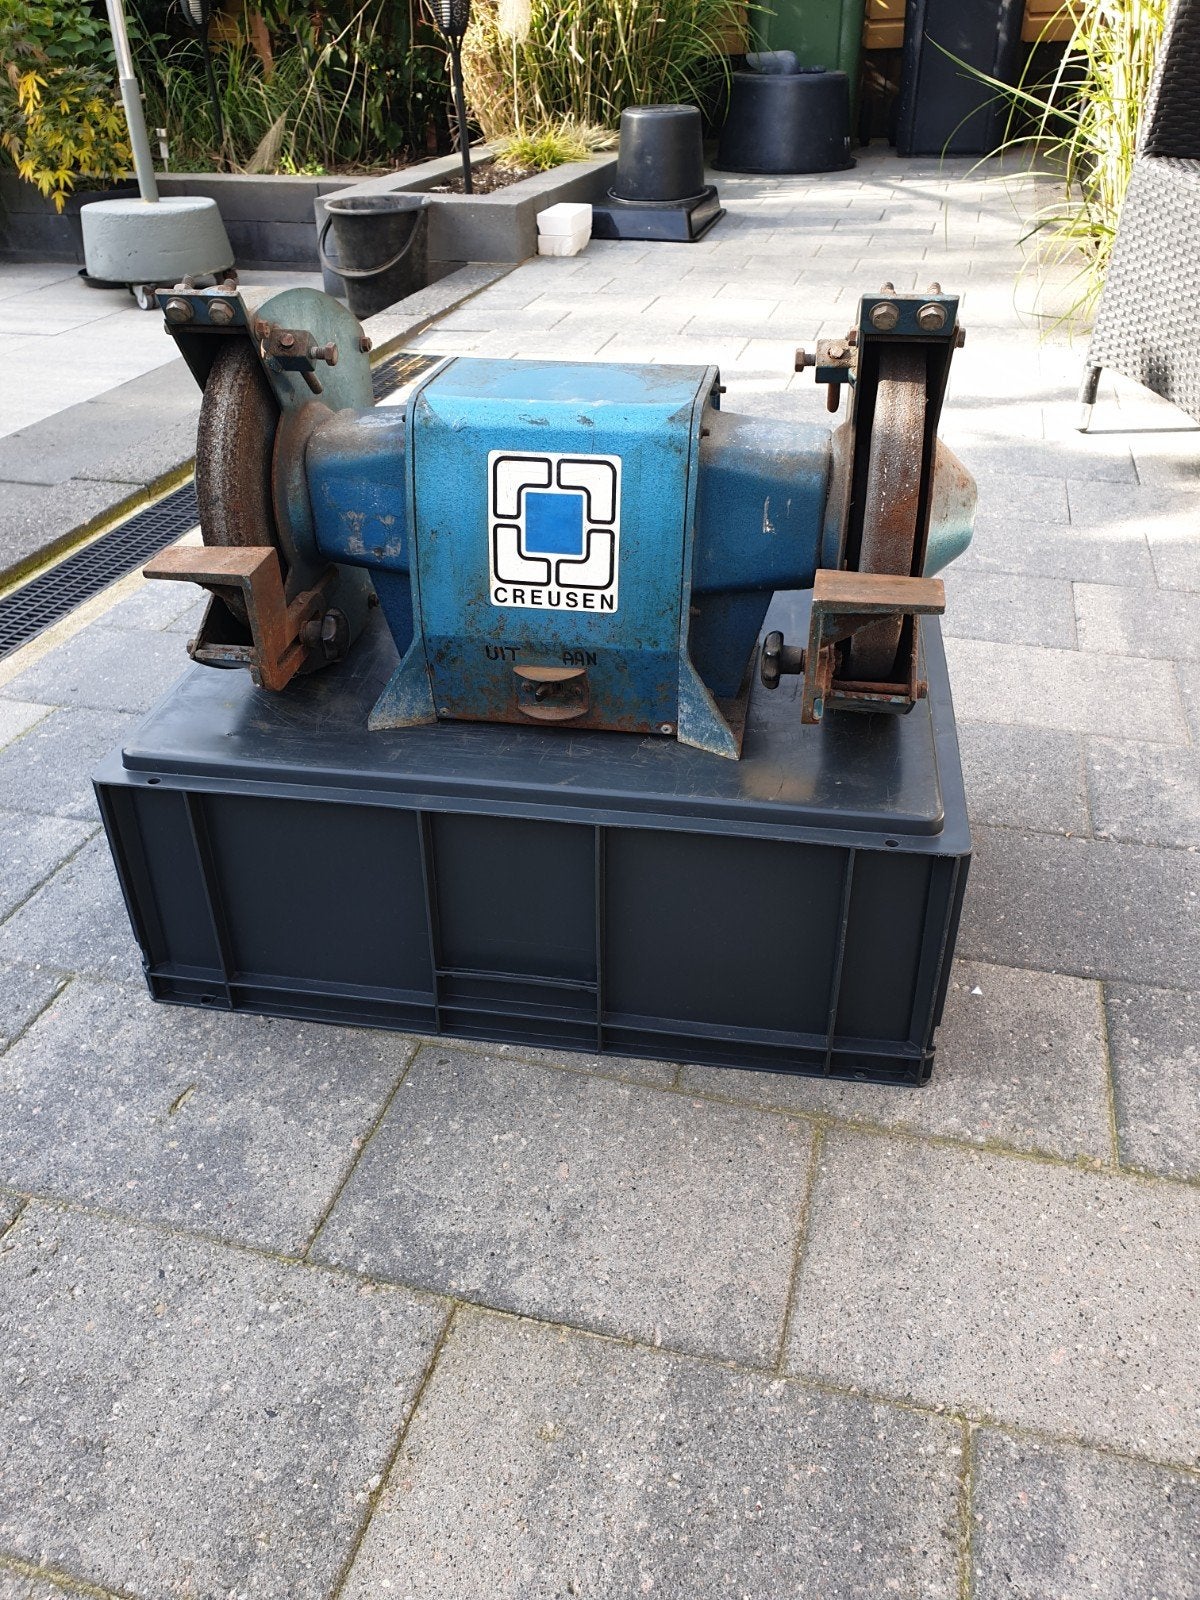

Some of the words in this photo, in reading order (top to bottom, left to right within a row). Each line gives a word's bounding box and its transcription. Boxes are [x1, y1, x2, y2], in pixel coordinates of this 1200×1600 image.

[493, 587, 615, 610] CREUSEN
[485, 645, 521, 662] UIT
[562, 650, 598, 667] AAN
